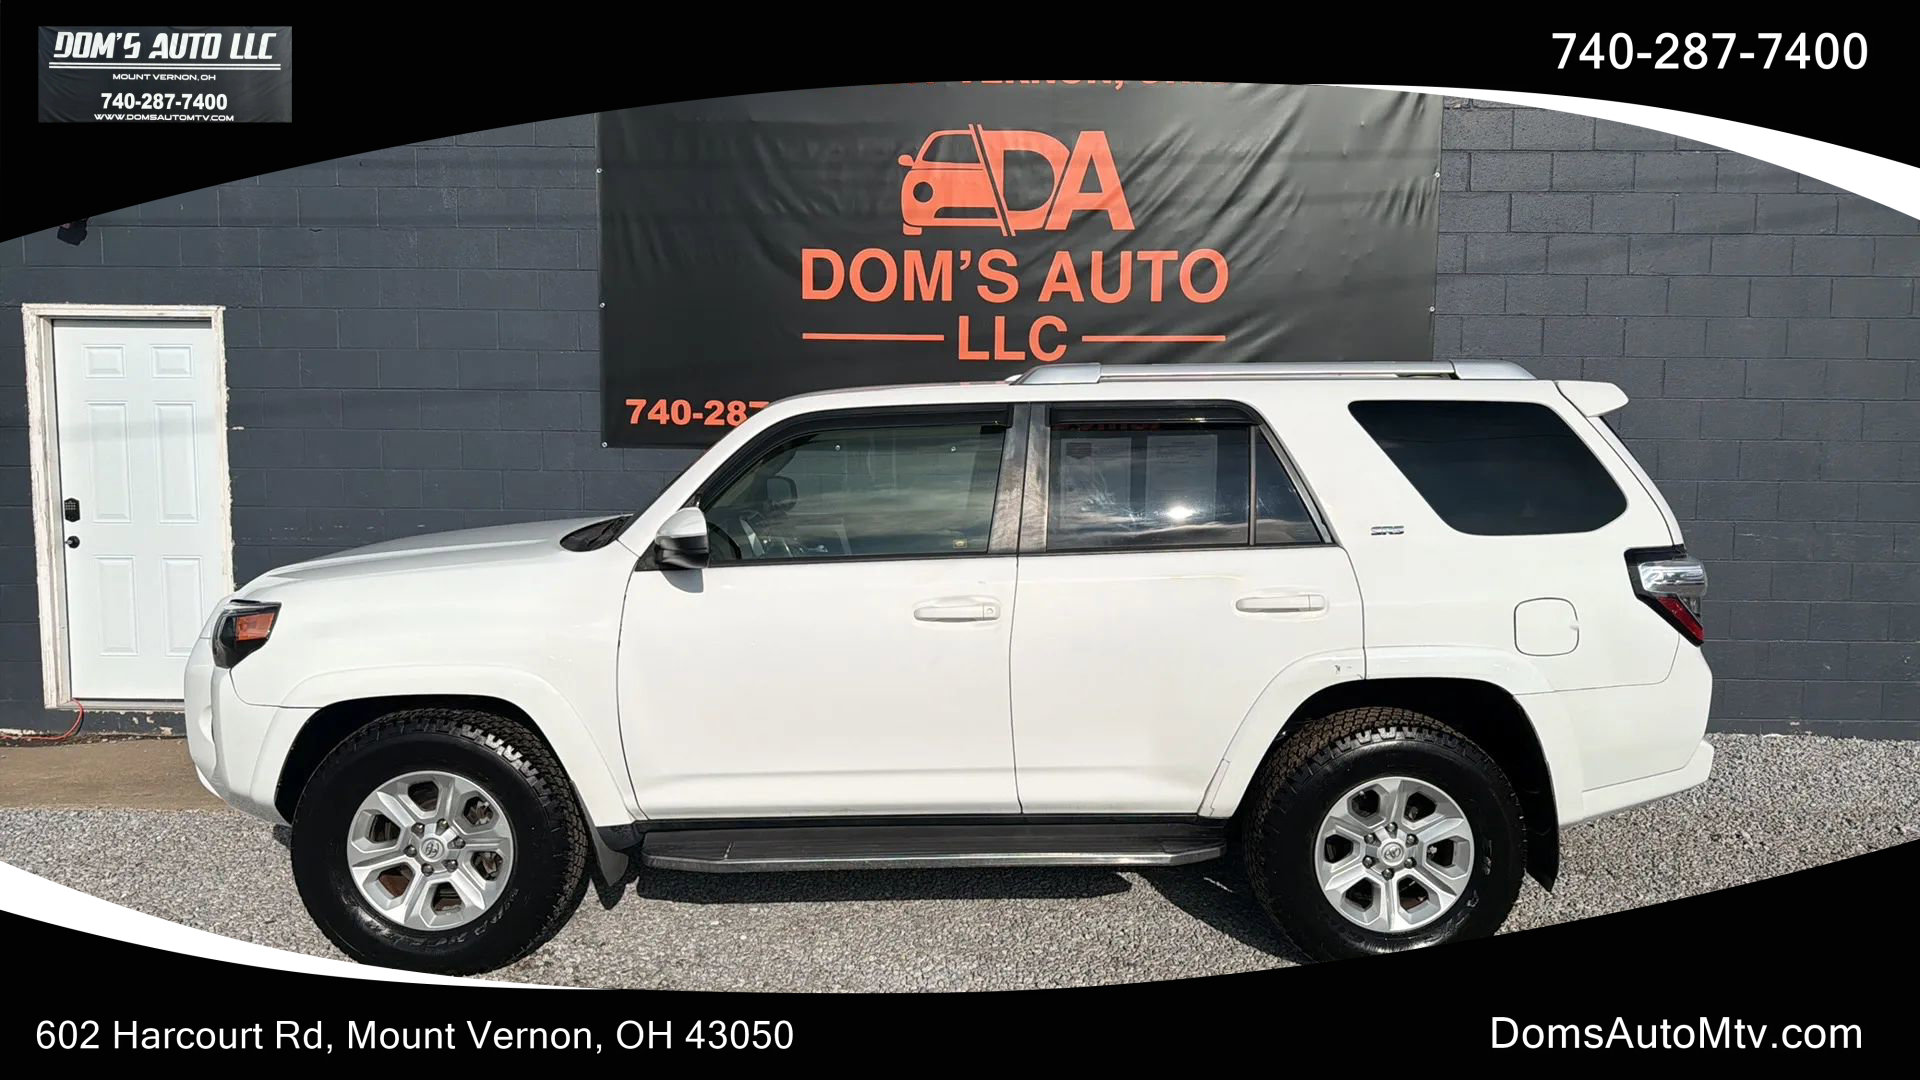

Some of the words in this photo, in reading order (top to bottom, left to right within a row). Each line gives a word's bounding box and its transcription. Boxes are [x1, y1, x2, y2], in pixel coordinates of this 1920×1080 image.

[801, 247, 1021, 305] DOM'S
[1039, 249, 1229, 305] AUTO
[959, 315, 1068, 363] LLC
